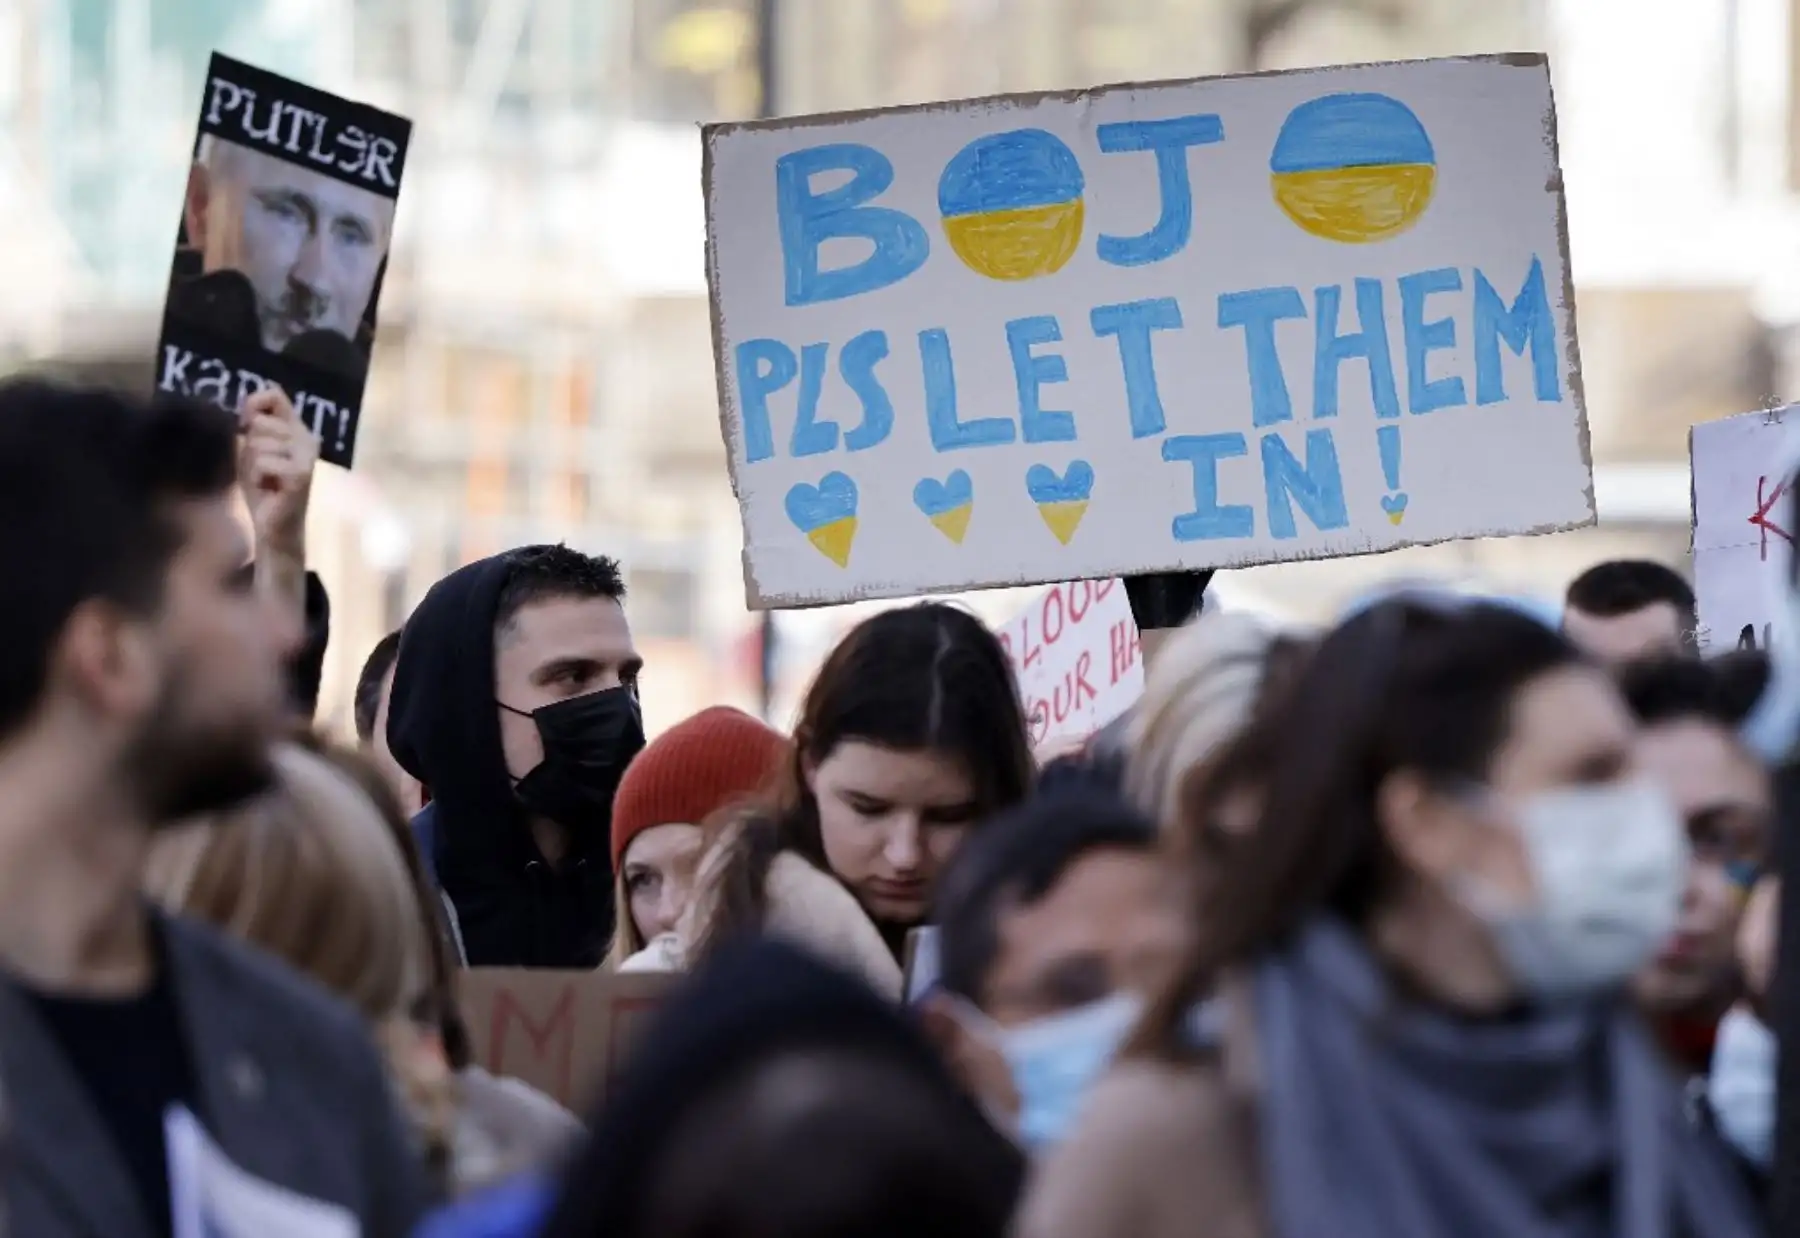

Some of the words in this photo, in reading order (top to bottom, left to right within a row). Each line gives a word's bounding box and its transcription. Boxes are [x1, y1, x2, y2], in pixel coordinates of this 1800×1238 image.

[736, 329, 895, 463] PLS
[918, 296, 1183, 452] LET
[1217, 252, 1562, 428] THEM
[1162, 424, 1408, 543] IN!
